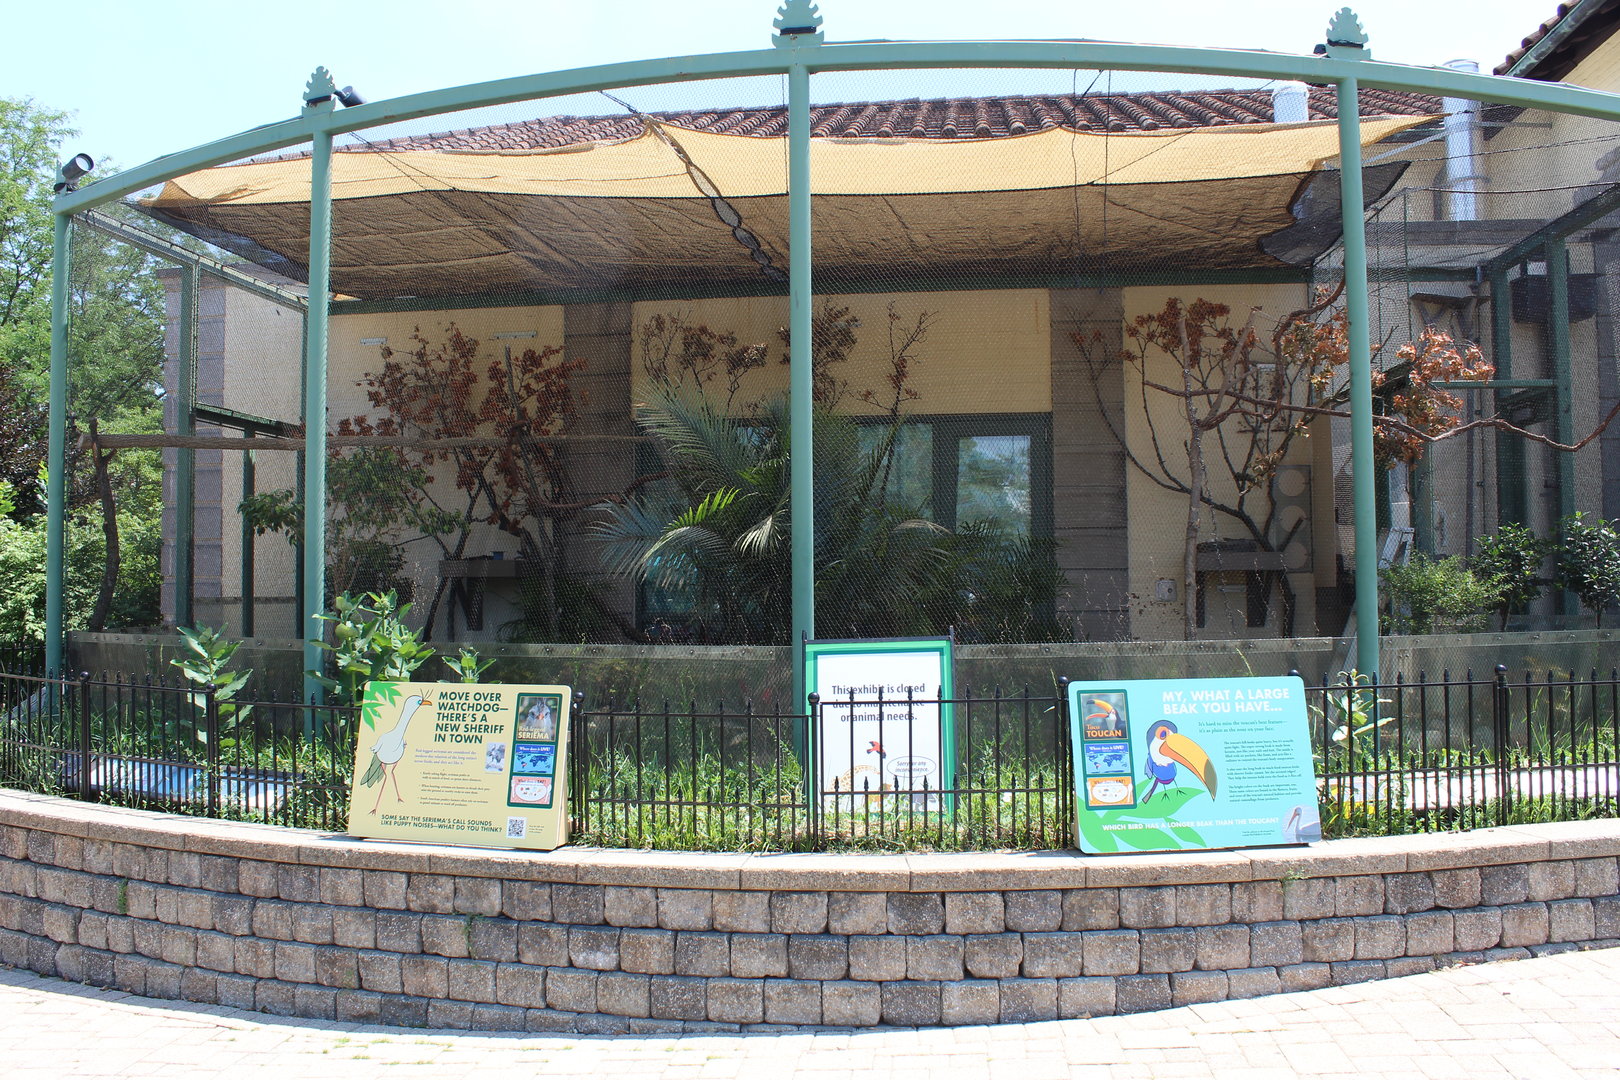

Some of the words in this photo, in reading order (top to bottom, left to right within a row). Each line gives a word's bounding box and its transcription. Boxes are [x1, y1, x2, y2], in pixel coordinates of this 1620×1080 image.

[831, 685, 851, 694] This
[887, 683, 895, 693] is
[439, 691, 470, 701] MOVE
[473, 692, 502, 702] OVER
[1162, 691, 1187, 703] MY,
[1190, 689, 1231, 701] WHAT
[1235, 689, 1245, 700] A
[1247, 688, 1290, 700] LARGE
[1163, 703, 1198, 715] BEAK
[1201, 702, 1231, 713] YOU
[480, 713, 488, 723] A
[435, 723, 460, 732] NEW
[463, 724, 505, 734] SHERIFF
[1086, 729, 1122, 738] TOUCAN
[434, 733, 446, 743] IN
[449, 734, 483, 744] TOWN
[517, 731, 549, 739] SERIEMA
[467, 819, 492, 827] SOUNDS
